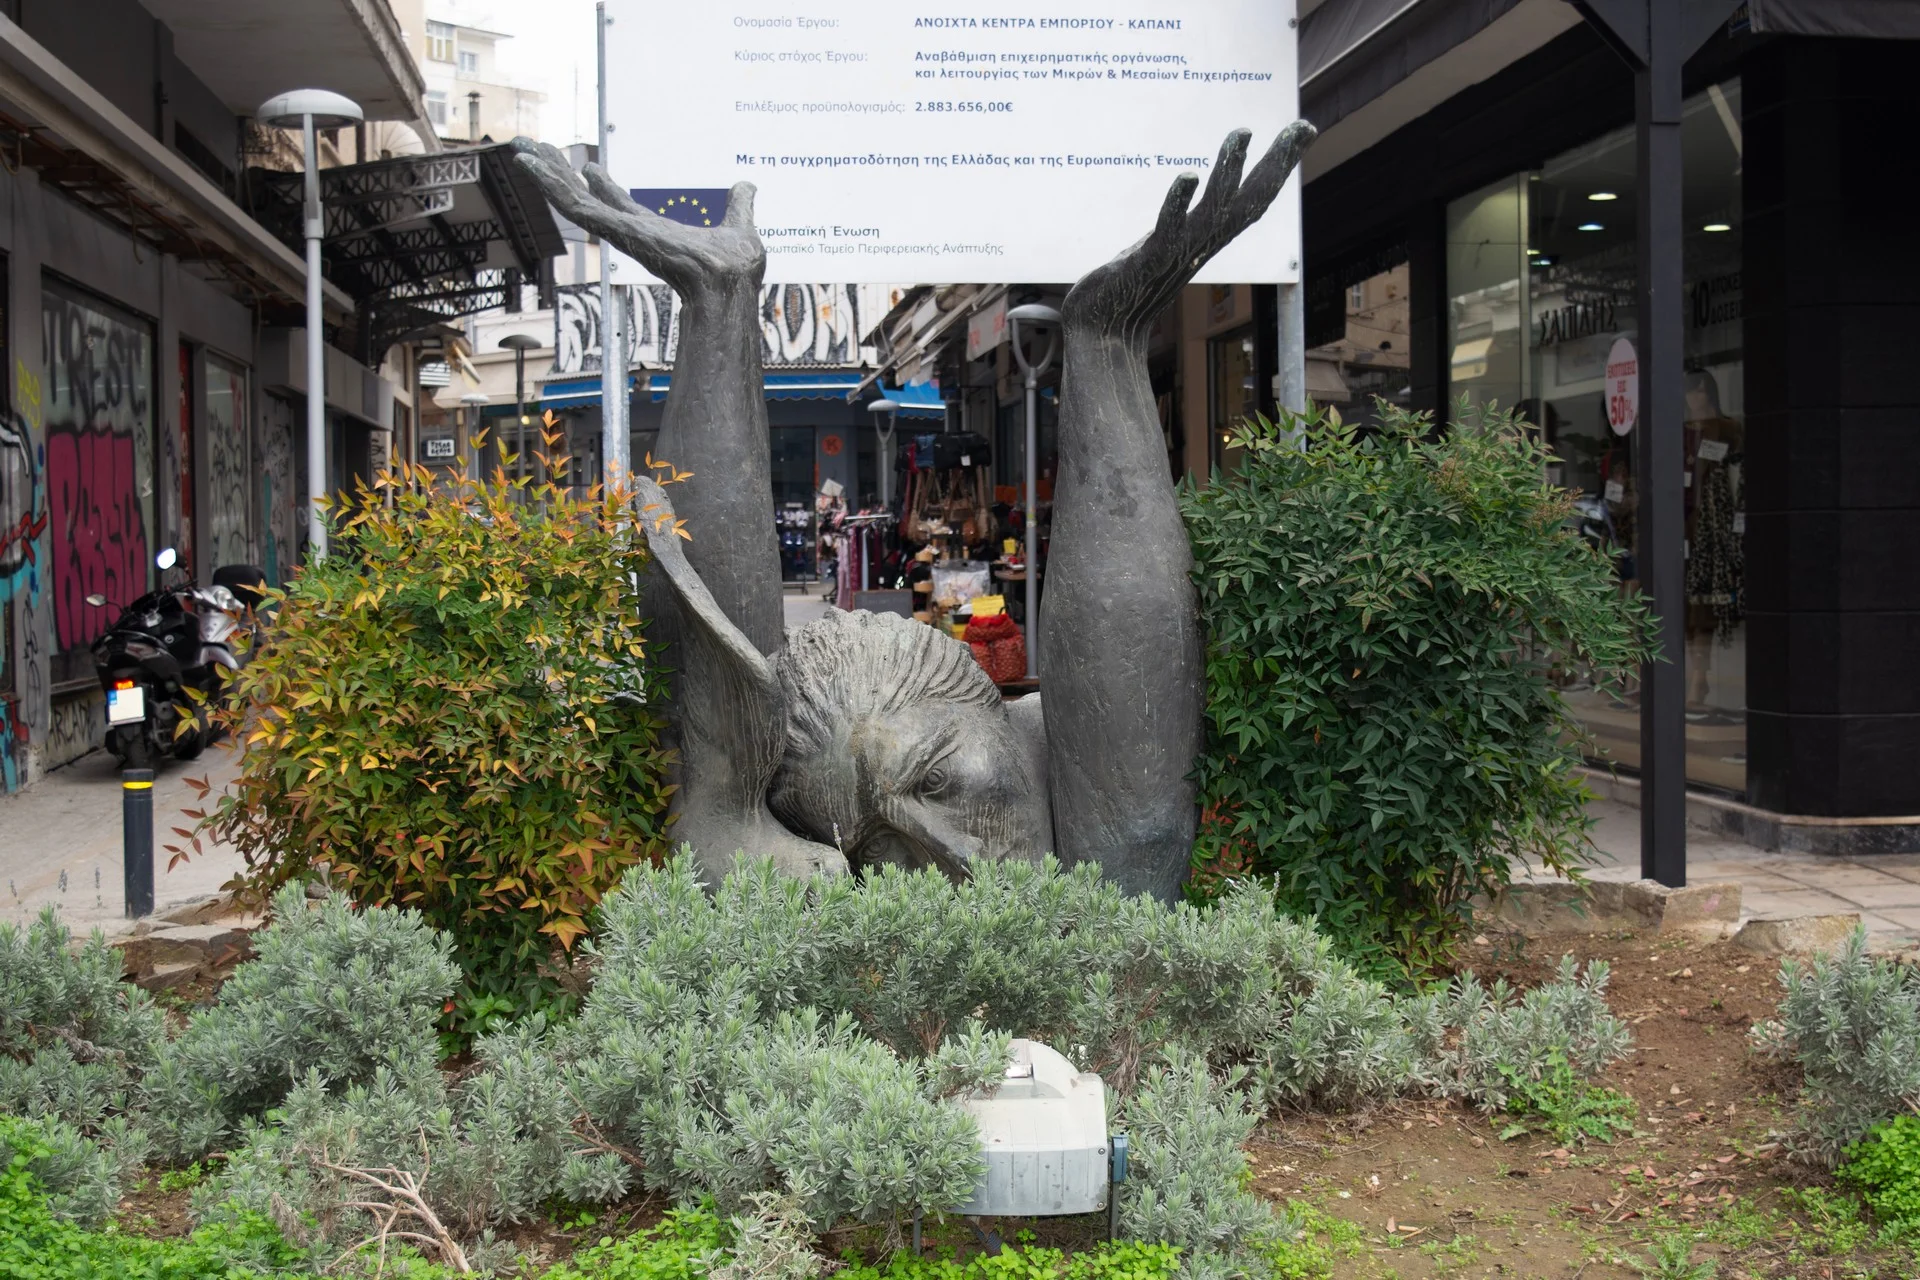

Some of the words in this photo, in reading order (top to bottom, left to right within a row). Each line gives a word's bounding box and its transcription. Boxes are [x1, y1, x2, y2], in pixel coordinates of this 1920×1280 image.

[734, 16, 792, 29] Ονομασία
[796, 16, 840, 30] Έργου:
[915, 18, 977, 29] ΑΝΟΙΧΤΑ
[981, 18, 1036, 29] ΚΕΝΤΡΑ
[1040, 18, 1115, 30] ΕΜΠΟΡΙΟΥ
[1128, 19, 1182, 30] ΚΑΠΑΝΙ
[734, 50, 775, 64] Κύριος
[778, 50, 822, 64] στόχος
[825, 50, 868, 64] Έργου:
[915, 51, 996, 65] Αναβάθμιση
[1000, 51, 1109, 66] επιχειρηματικής
[1112, 52, 1188, 66] οργάνωσης
[915, 69, 935, 79] και
[940, 67, 1020, 82] λειτουργίας
[1023, 70, 1048, 80] των
[1052, 68, 1103, 81] Μικρών
[1107, 69, 1117, 80] &
[1121, 68, 1179, 81] Μεσαίων
[1183, 68, 1273, 83] Επιχειρήσεων
[735, 100, 799, 115] Επιλέξιμος
[802, 100, 907, 115] προϋπολογισμός:
[915, 101, 1014, 114] 2.883.656,00€
[736, 153, 756, 166] Με
[760, 155, 776, 168] τη
[780, 153, 920, 169] συγχρηματοδότηση
[923, 155, 948, 169] της
[951, 153, 1011, 168] Ελλάδας
[1014, 155, 1036, 167] και
[1040, 156, 1064, 169] της
[1067, 154, 1151, 169] Ευρωπαϊκής
[1154, 154, 1210, 169] Ένωσης
[830, 225, 881, 239] Ένωση
[766, 243, 815, 256] ρωπαϊκό
[818, 243, 855, 256] Ταμείο
[858, 243, 940, 257] Περιφερειακής
[942, 243, 1004, 257] Ανάπτυξης
[1690, 280, 1709, 328] 10
[1611, 395, 1633, 426] 50%
